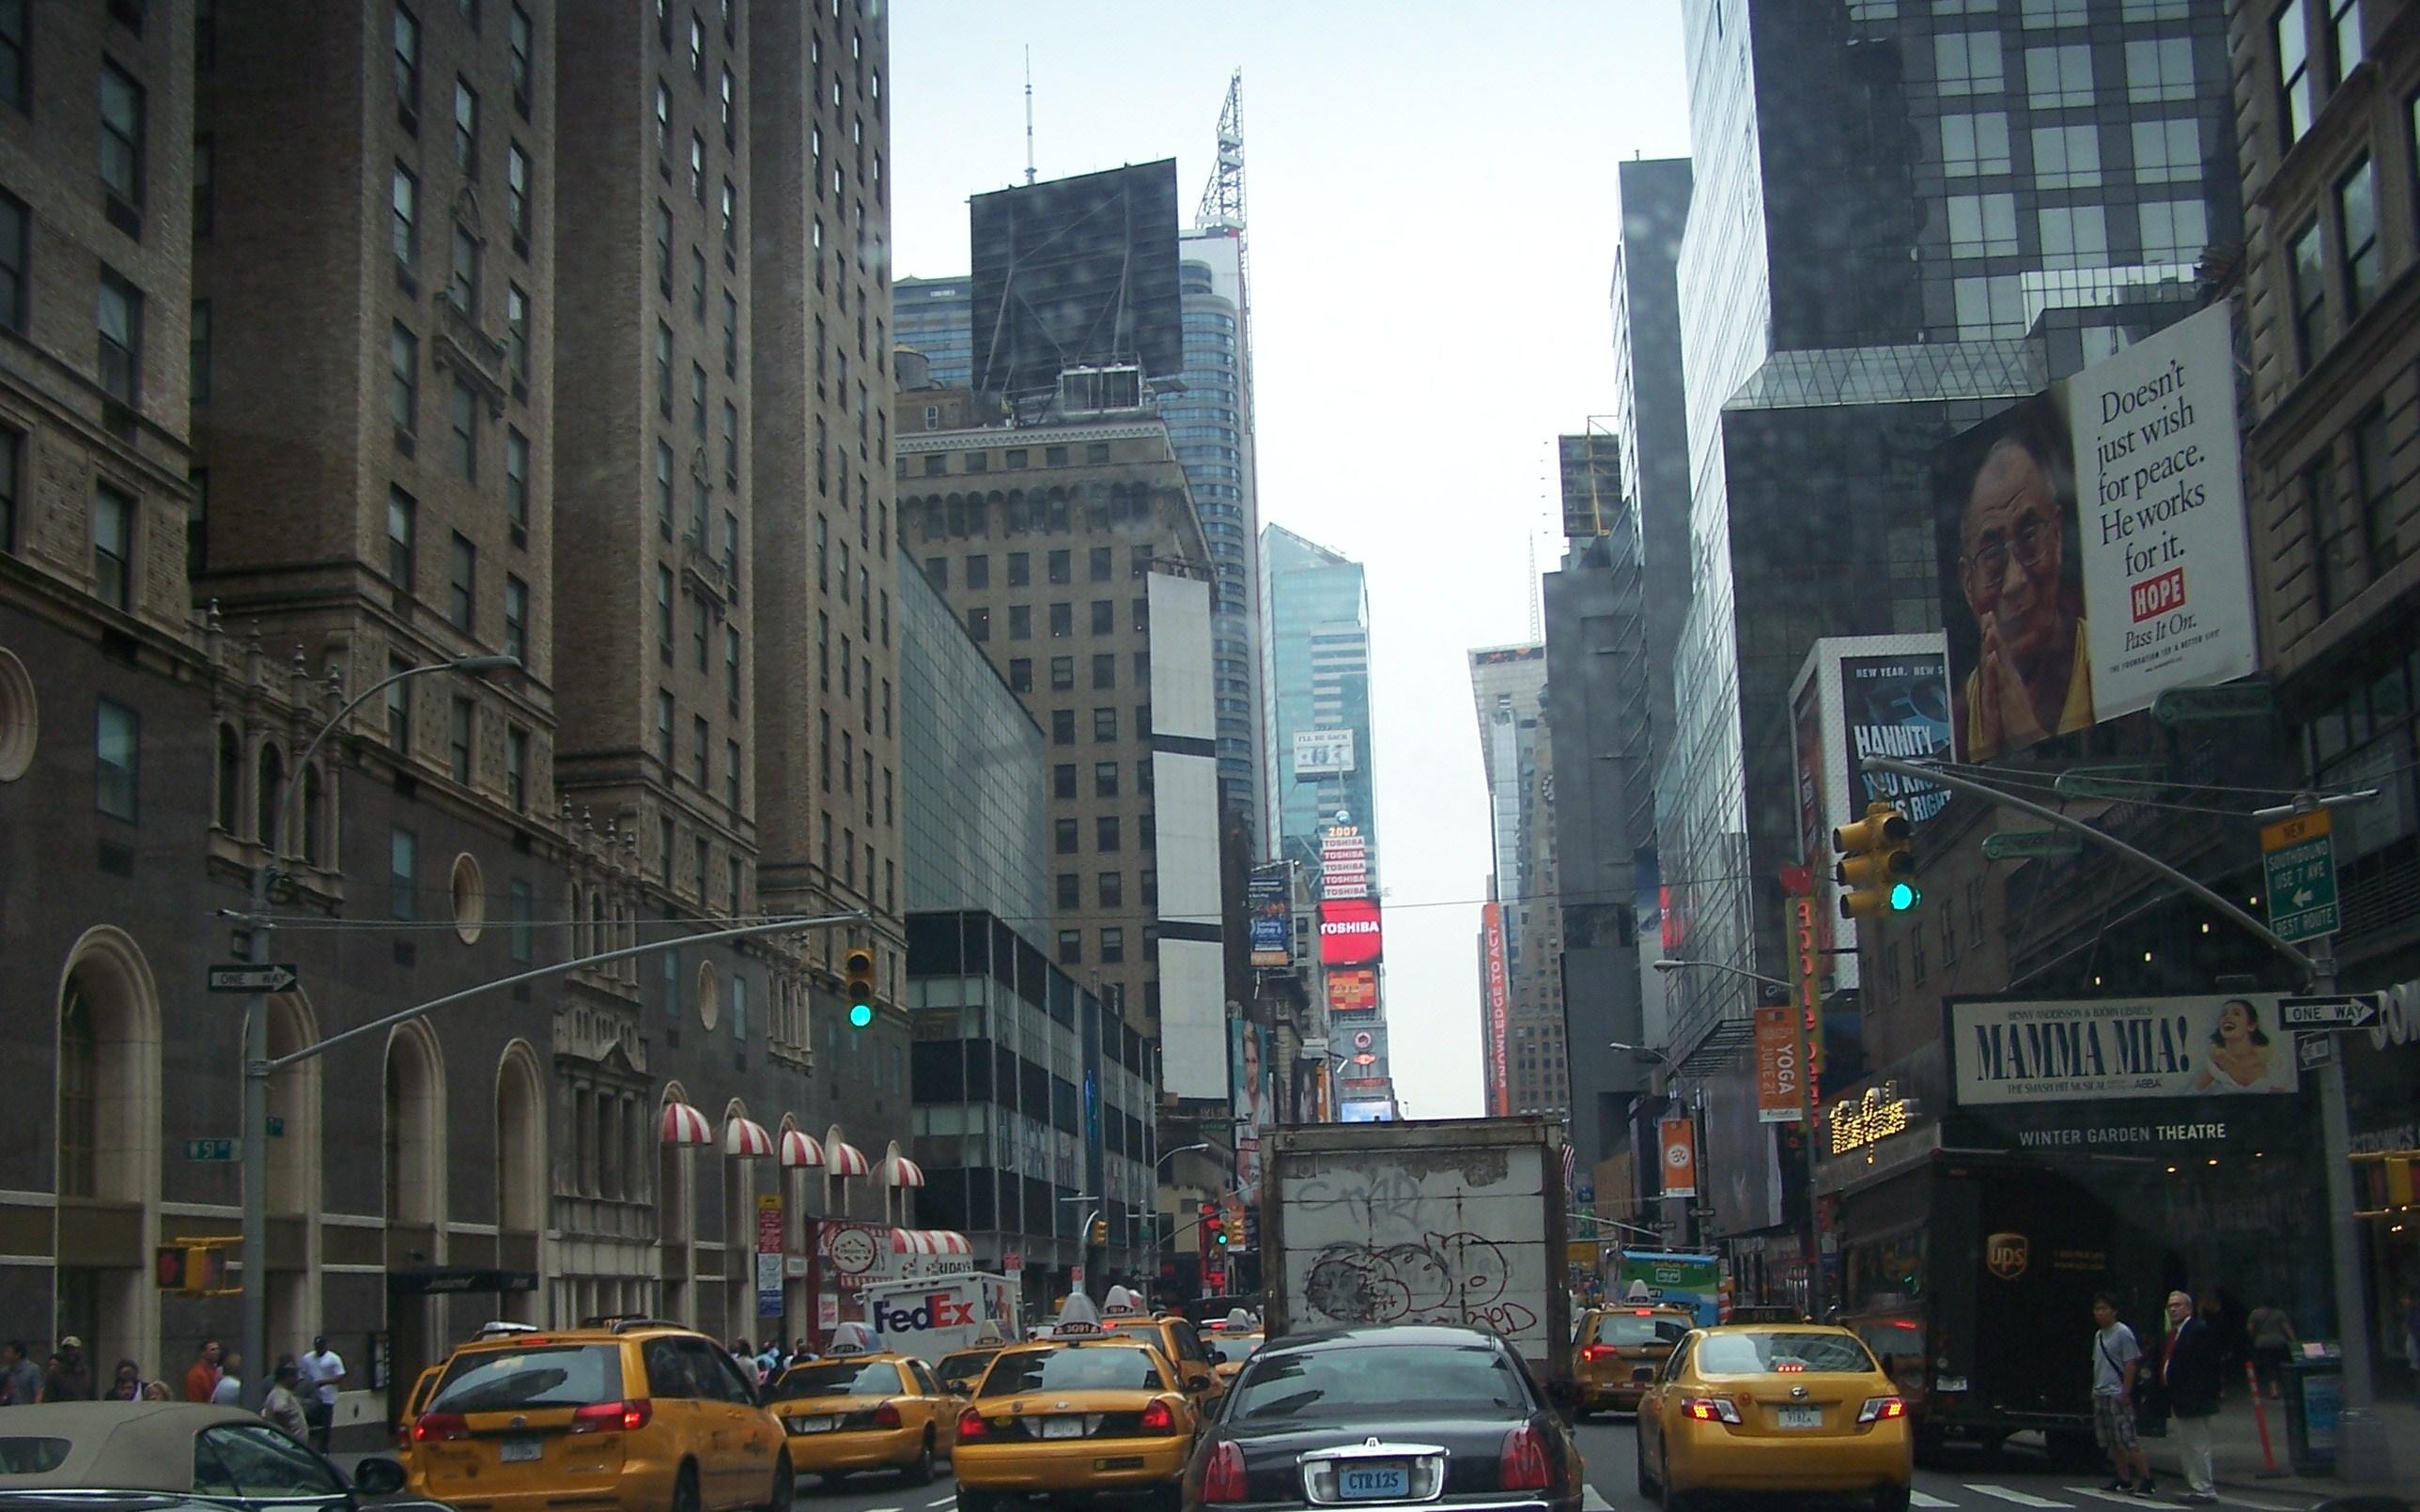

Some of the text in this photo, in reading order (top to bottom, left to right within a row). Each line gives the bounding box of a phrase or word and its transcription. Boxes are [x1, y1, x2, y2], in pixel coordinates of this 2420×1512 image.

[2100, 359, 2186, 426] Doesn't
[2096, 397, 2195, 475] just wish
[2098, 444, 2206, 507] for peace.
[2099, 481, 2207, 547] He works
[2124, 532, 2186, 578] for it.
[2133, 573, 2182, 617] HOPE
[2125, 613, 2196, 652] Pass It On.
[1856, 668, 1877, 679] NEW
[1854, 725, 1933, 760] HANNITY
[1325, 839, 1364, 847] TOSHIBA
[1325, 851, 1364, 860] TOSHIBA
[1326, 863, 1365, 872] TOSHIBA
[1326, 874, 1365, 884] TOSHIBA
[2307, 860, 2326, 881] AVE
[1326, 887, 1366, 896] TOSHIBA
[1320, 921, 1380, 934] TOSHIBA
[2302, 907, 2334, 930] ROUTE
[221, 973, 245, 985] ONE
[1491, 962, 1501, 982] TO
[2292, 1005, 2365, 1021] ONE WAY
[1491, 985, 1508, 1089] KNOWLEDGE
[1975, 1015, 2191, 1082] MAMMA MIA!
[1761, 1044, 1775, 1079] JUNE
[1776, 1043, 1795, 1095] YOGA
[2018, 1121, 2227, 1148] WINTER GARDEN THEATRE
[203, 1140, 215, 1158] 51
[874, 1292, 976, 1335] FedEx
[1348, 1471, 1400, 1489] CTR125
